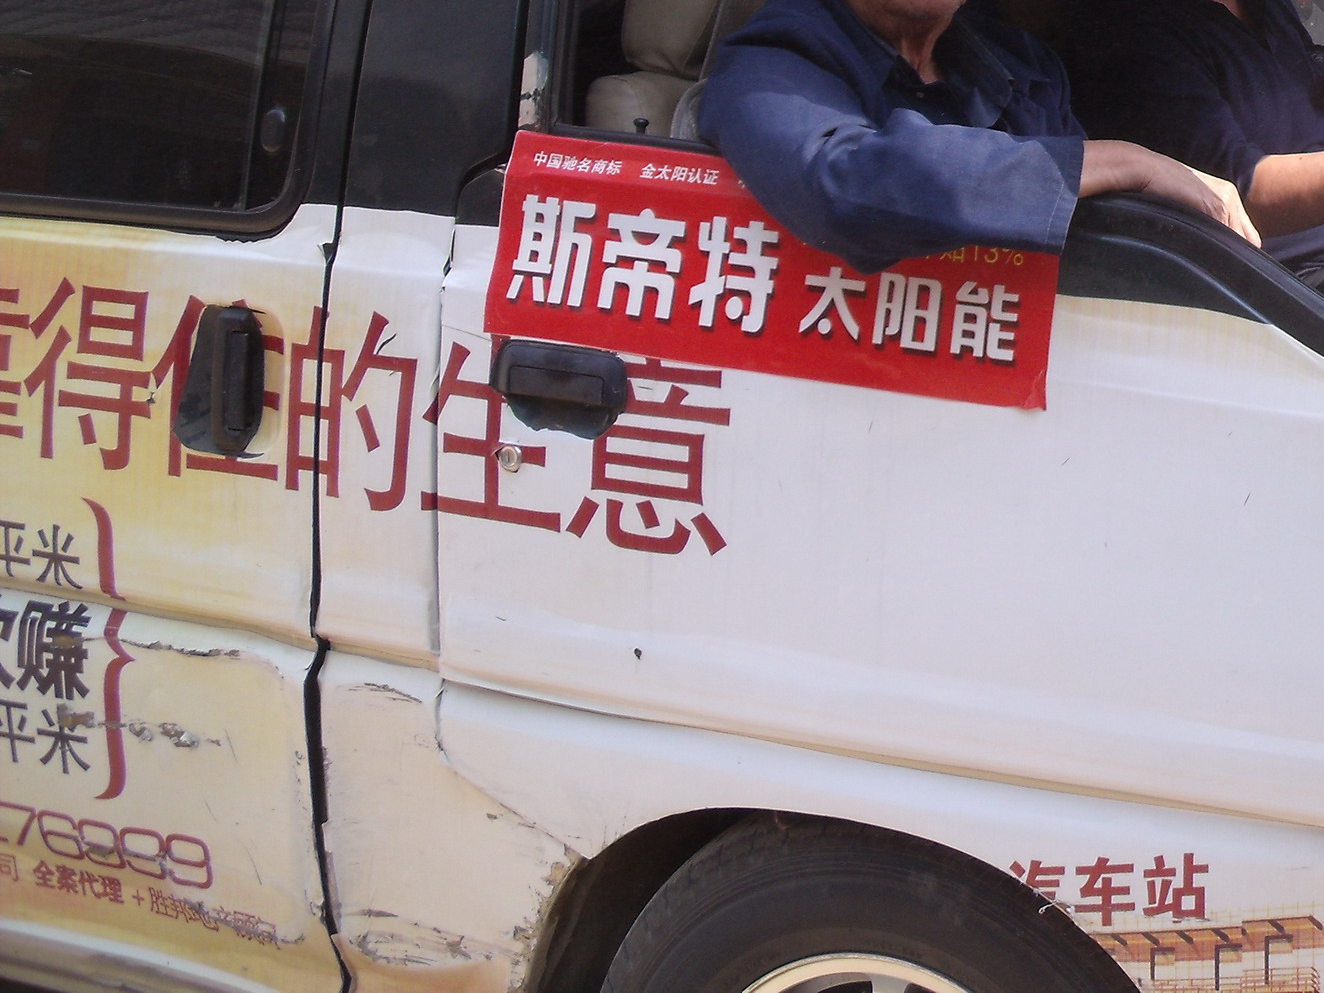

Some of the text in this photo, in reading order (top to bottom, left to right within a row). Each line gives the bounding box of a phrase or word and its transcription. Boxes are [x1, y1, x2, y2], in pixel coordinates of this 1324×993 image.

[533, 151, 622, 175] 中国驰名商标
[640, 163, 719, 186] 金太阳认证
[506, 194, 1019, 361] 斯帝特 太阳能
[0, 597, 92, 700] 赚
[0, 801, 213, 890] 76999
[33, 859, 124, 904] 全案代理
